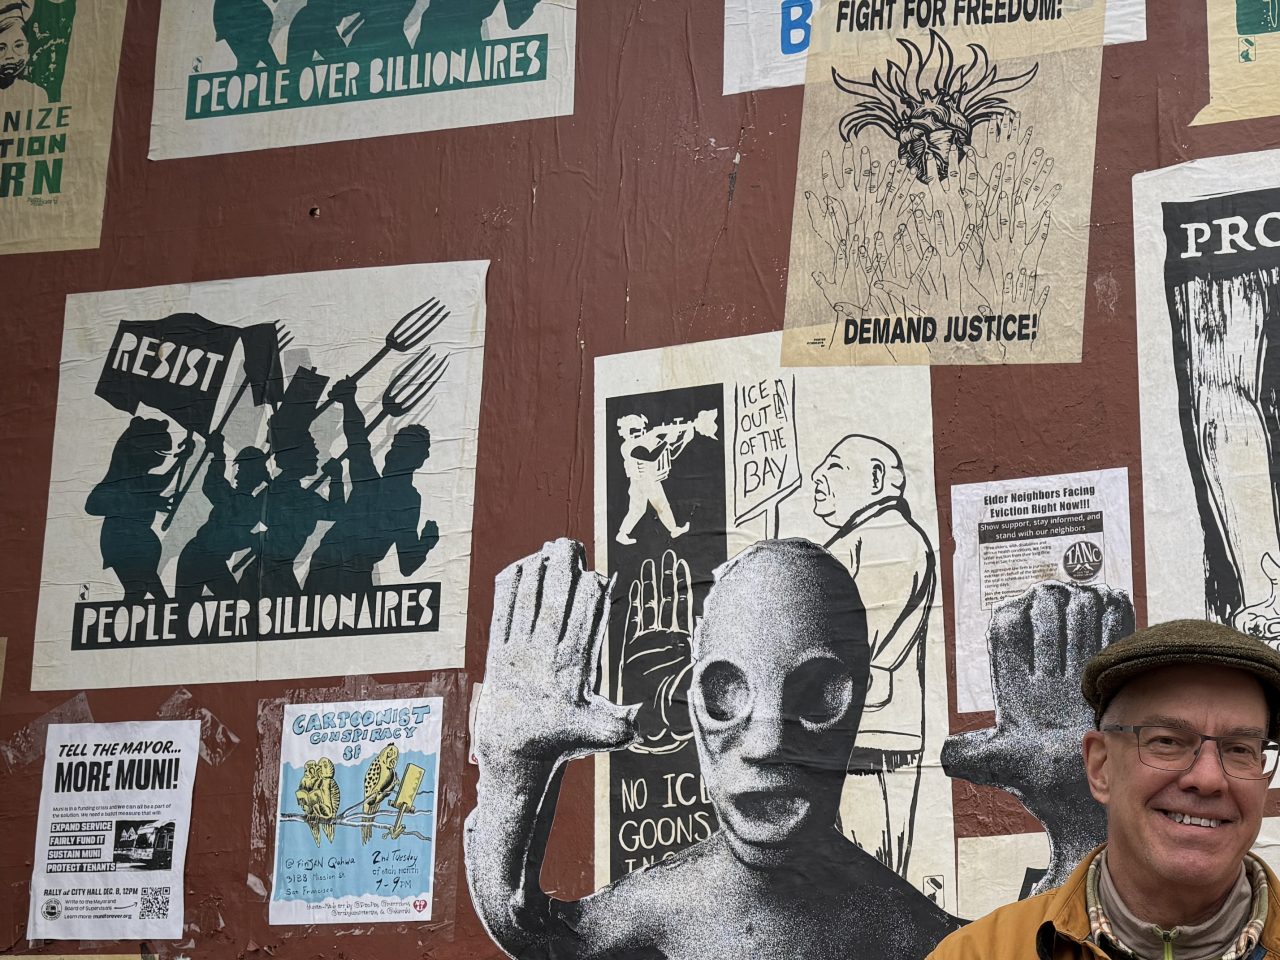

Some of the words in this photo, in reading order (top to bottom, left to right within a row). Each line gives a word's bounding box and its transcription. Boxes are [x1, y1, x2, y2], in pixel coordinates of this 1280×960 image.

[836, 0, 893, 32] FIGHT
[904, 0, 945, 28] FOR
[194, 69, 290, 114] PEOPLE
[299, 60, 359, 101] OVER
[369, 41, 541, 95] BILLIONAIRES
[844, 316, 937, 345] DEMAND
[944, 314, 1038, 343] JUSTICE!
[113, 332, 224, 392] RESIST
[742, 379, 769, 408] ICE
[741, 404, 771, 432] OUT
[740, 436, 756, 455] OF
[757, 427, 786, 452] THE
[744, 454, 787, 498] BAY
[984, 495, 1008, 506] Elder
[1010, 490, 1060, 503] Neighbors
[1063, 486, 1095, 498] Facing
[990, 507, 1029, 518] Eviction
[1031, 503, 1057, 515] Right
[1059, 499, 1090, 511] Now!!!
[980, 522, 999, 532] Show
[1001, 520, 1032, 533] support,
[1033, 518, 1049, 528] stay
[1050, 515, 1085, 525] informed,
[1087, 513, 1101, 521] and
[995, 530, 1016, 540] stand
[1018, 528, 1034, 537] with
[1050, 525, 1086, 535] neighbors
[1066, 542, 1102, 565] TANC
[81, 599, 178, 644] PEOPLE
[188, 600, 248, 638] OVER
[258, 590, 434, 634] BILLIONAIRES
[292, 705, 431, 735] CARTOONIST
[310, 726, 417, 744] CONSPIRACY
[59, 743, 88, 758] TELL
[92, 743, 120, 757] THE
[120, 740, 181, 755] MAYOR...
[343, 744, 362, 761] SF
[54, 761, 113, 793] MORE
[115, 757, 180, 791] MUNI!
[621, 778, 647, 813] NO
[51, 822, 80, 832] EXPAND
[82, 821, 112, 831] SERVICE
[619, 811, 711, 852] GOONS
[50, 836, 75, 846] FAIRLY
[76, 835, 95, 845] FUND
[96, 835, 105, 844] IT
[48, 850, 80, 859] SUSTAIN
[82, 849, 100, 858] MUNI
[285, 858, 295, 869] @
[372, 850, 389, 865] 2nd
[392, 849, 418, 868] Tuesday
[47, 864, 81, 872] PROTECT
[82, 863, 116, 871] TENANTS
[372, 867, 380, 875] of
[399, 866, 419, 875] month
[312, 874, 336, 882] Mission
[302, 886, 334, 895] Francisco
